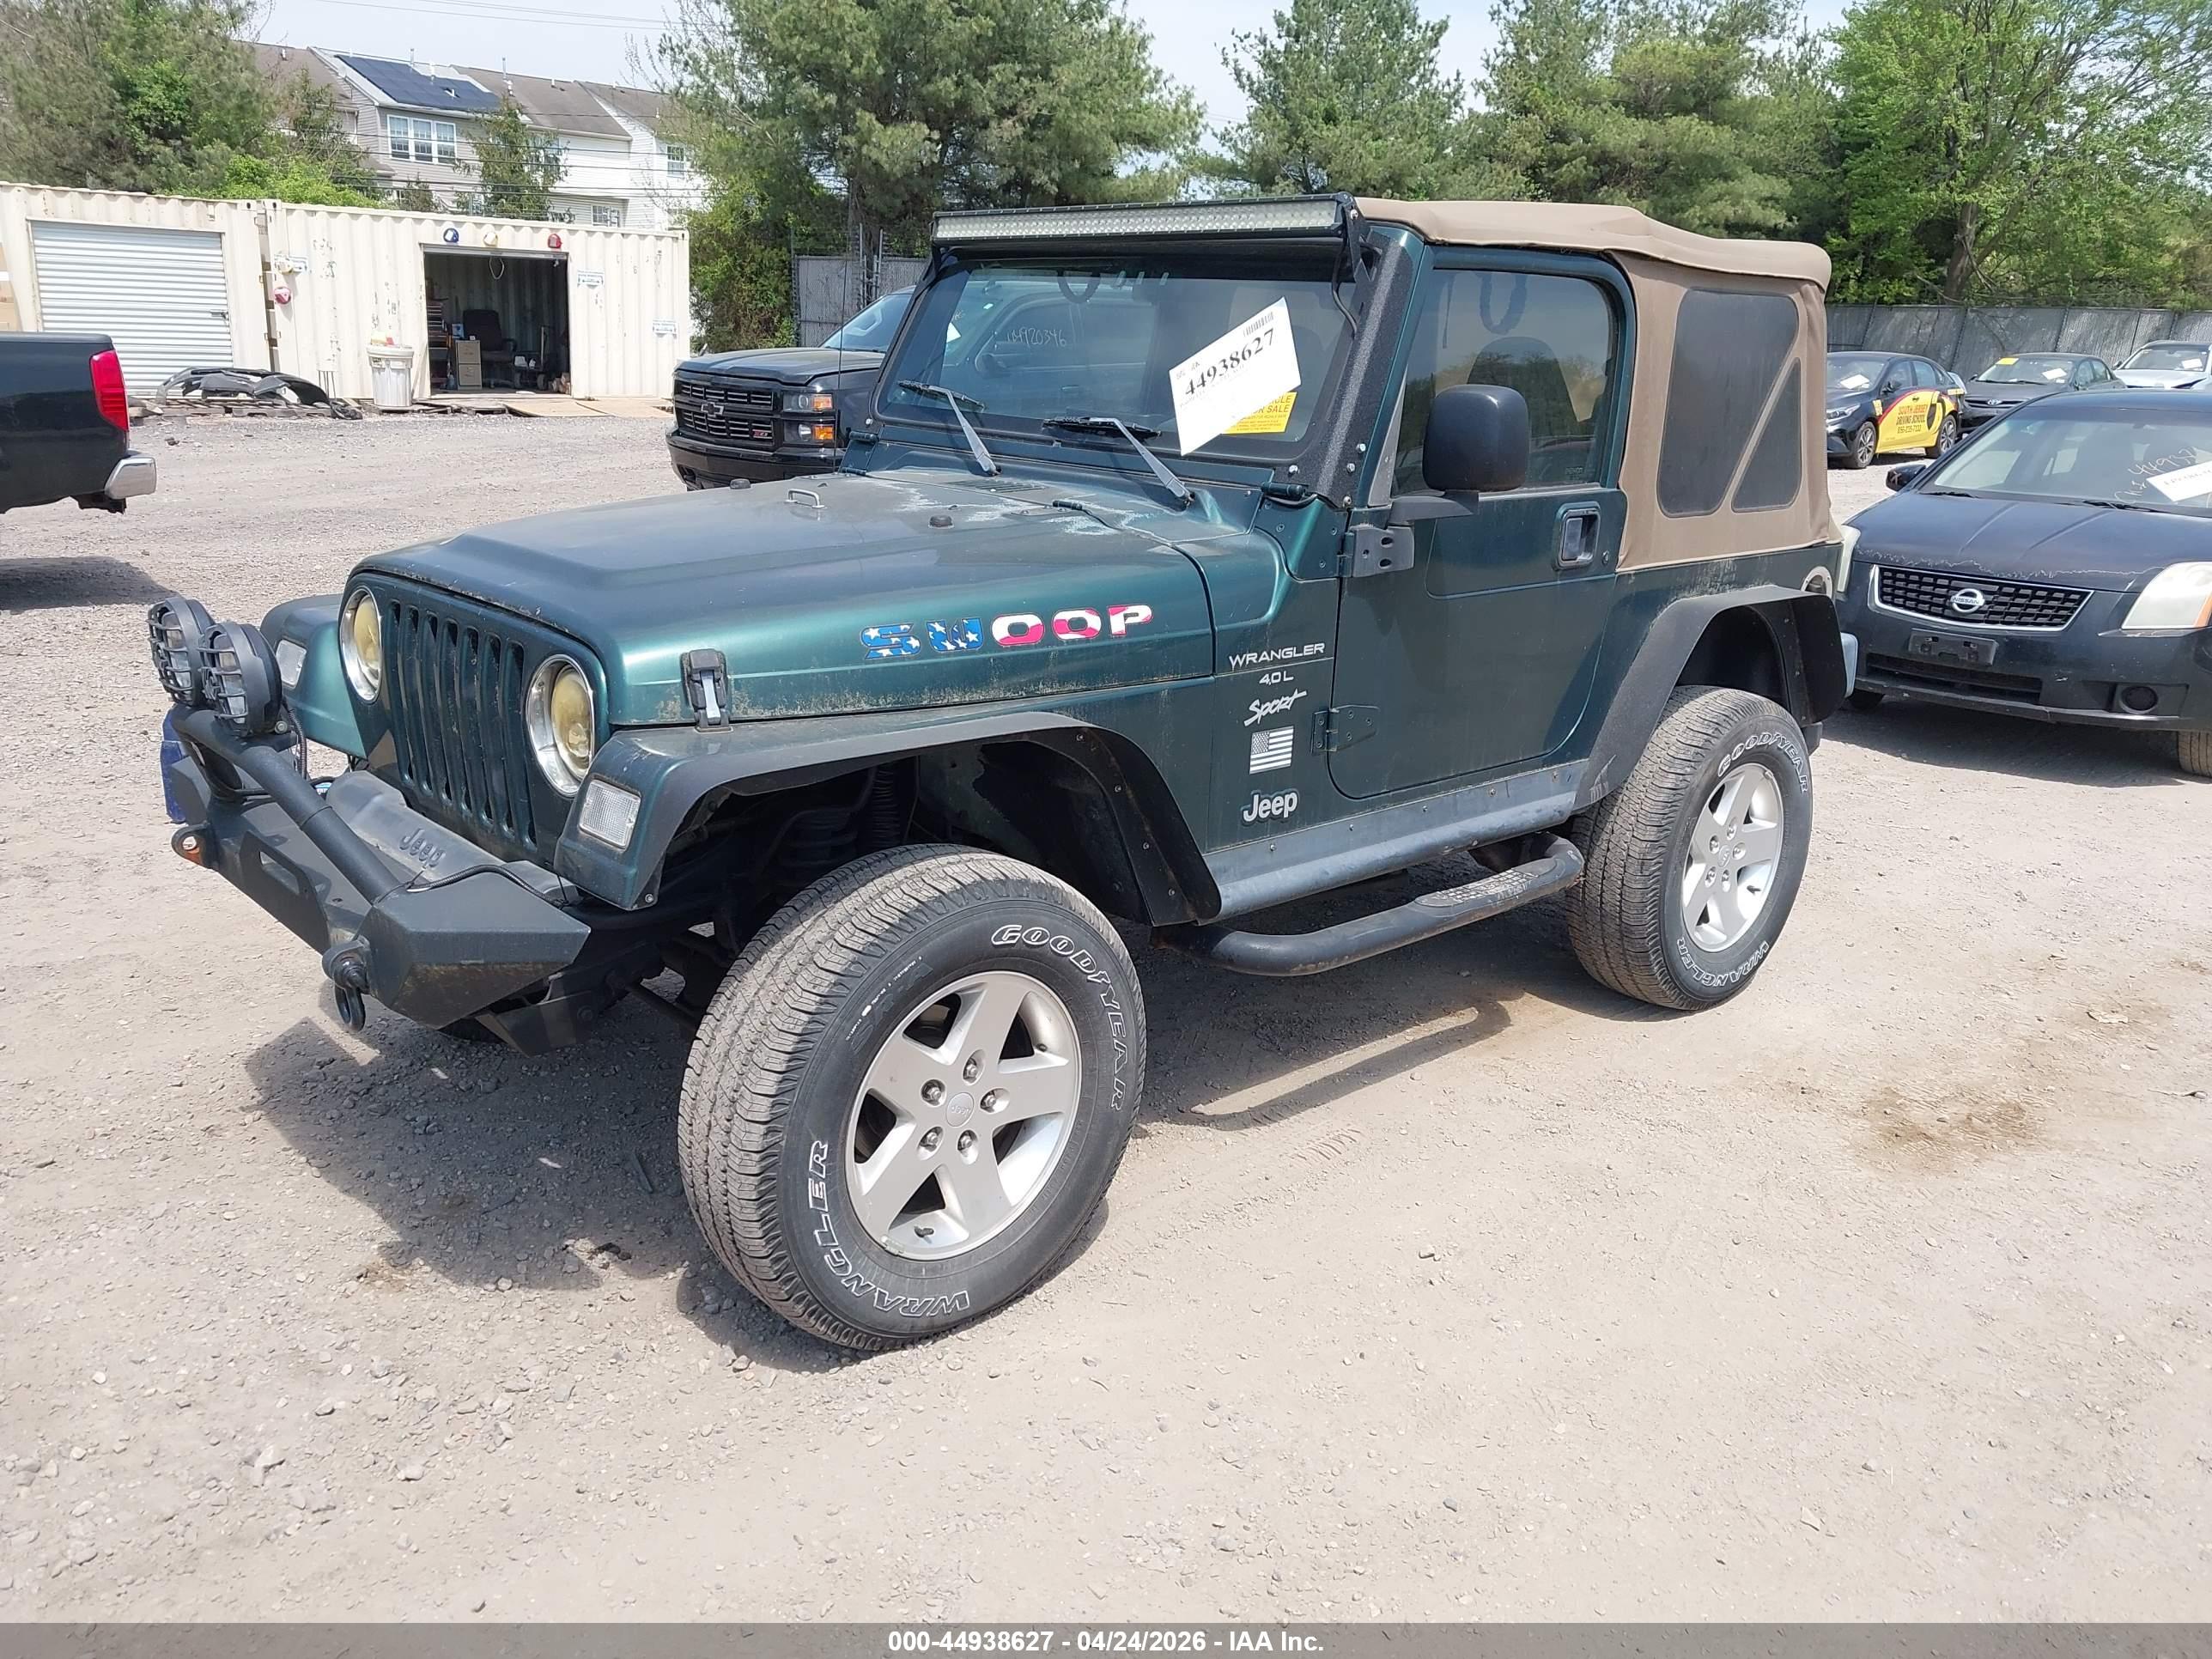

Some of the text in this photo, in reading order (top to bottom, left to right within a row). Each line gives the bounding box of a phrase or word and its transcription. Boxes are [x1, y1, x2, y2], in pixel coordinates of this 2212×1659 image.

[1185, 327, 1274, 396] 44938627
[1952, 596, 1981, 605] NISSAN
[860, 604, 1154, 659] SWOOP
[1229, 642, 1326, 671] WRANGLER
[1717, 732, 1809, 794] GOODYEAR
[1243, 790, 1298, 823] Jeep
[398, 828, 447, 869] Jeep
[1676, 937, 1770, 988] WRANGLER
[990, 923, 1128, 1111] GOODYEAR
[808, 1139, 970, 1320] WRANGLER
